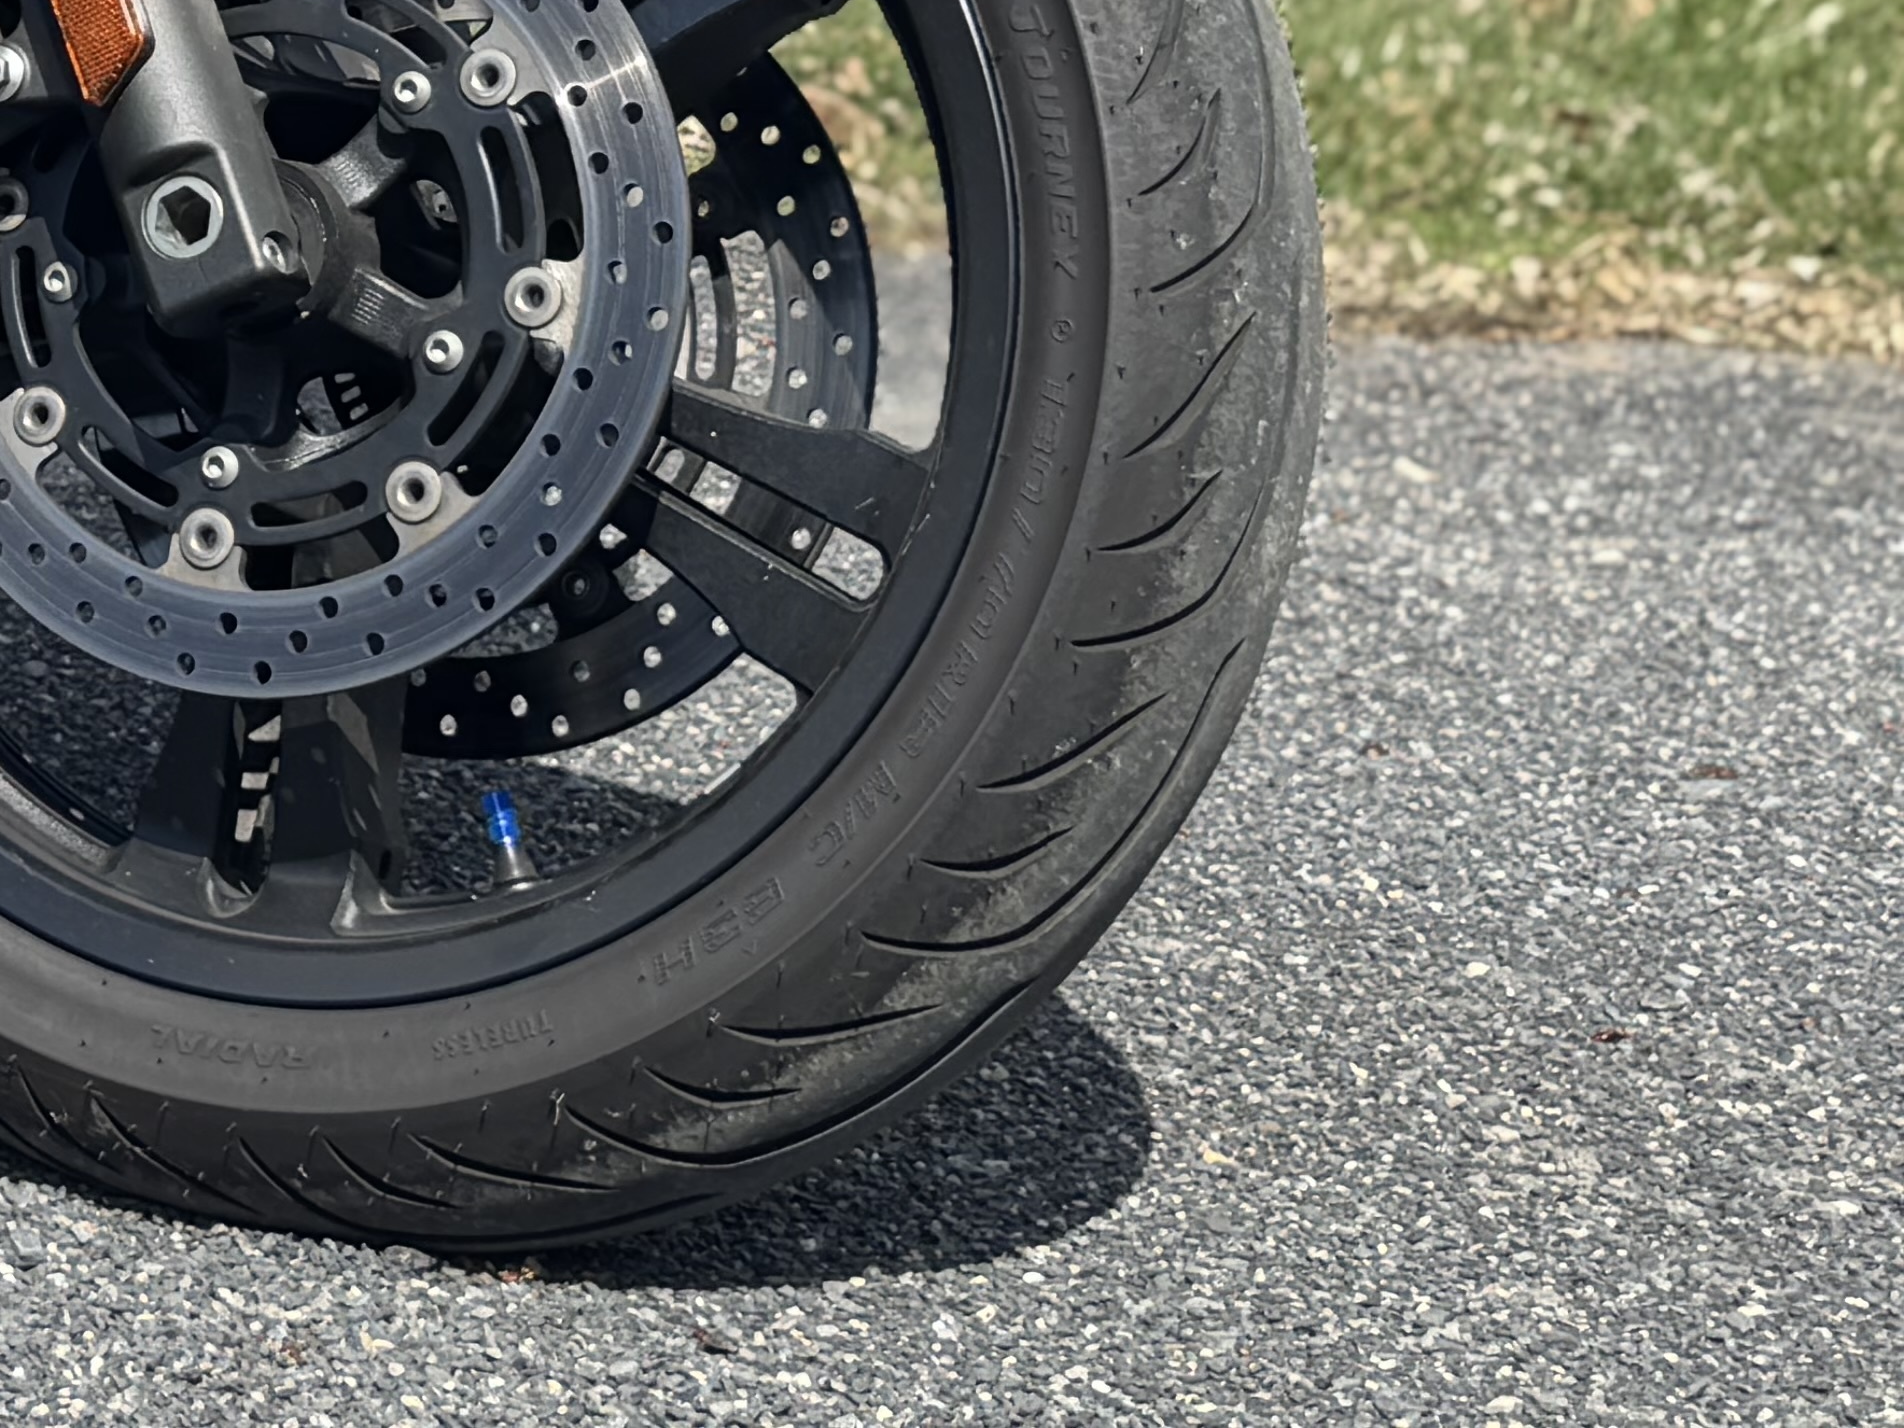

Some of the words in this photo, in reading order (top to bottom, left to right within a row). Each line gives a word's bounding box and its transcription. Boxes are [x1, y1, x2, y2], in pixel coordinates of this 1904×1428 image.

[1008, 3, 1080, 278] JOURNEY
[148, 1023, 309, 1069] RADIAL
[430, 1010, 552, 1059] TUBELESS
